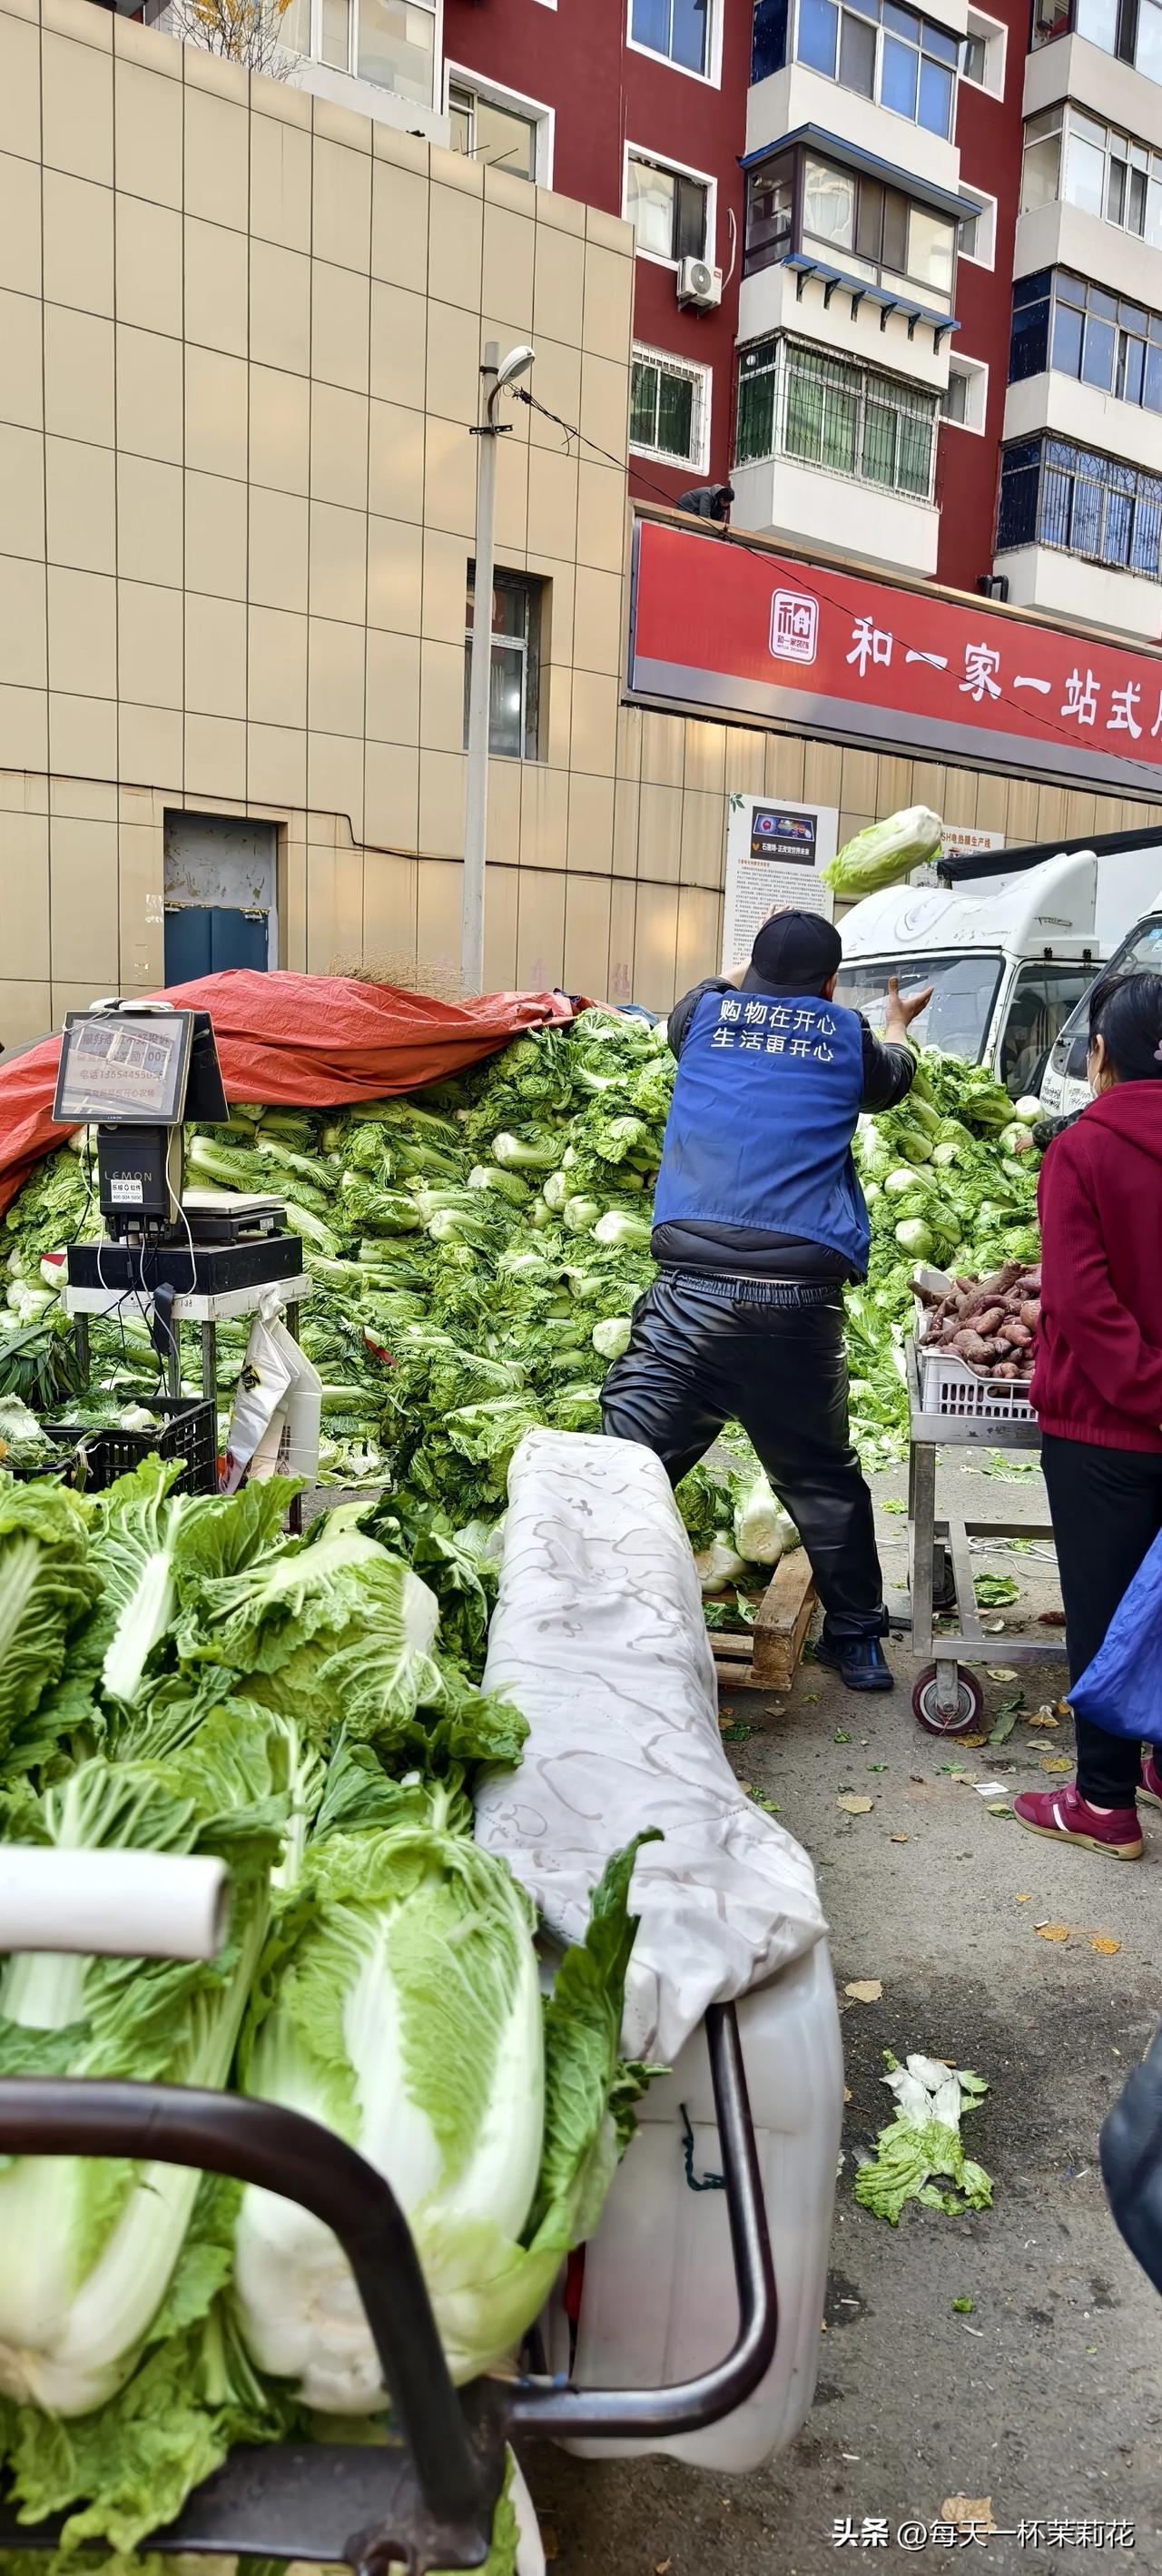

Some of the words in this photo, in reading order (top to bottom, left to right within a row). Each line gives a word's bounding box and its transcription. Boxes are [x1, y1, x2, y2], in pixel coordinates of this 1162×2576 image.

[845, 616, 1162, 741] 和一家一站式
[717, 1000, 837, 1036] 购物在开心
[710, 1027, 834, 1062] 生活更开心
[104, 1170, 153, 1181] LEMON
